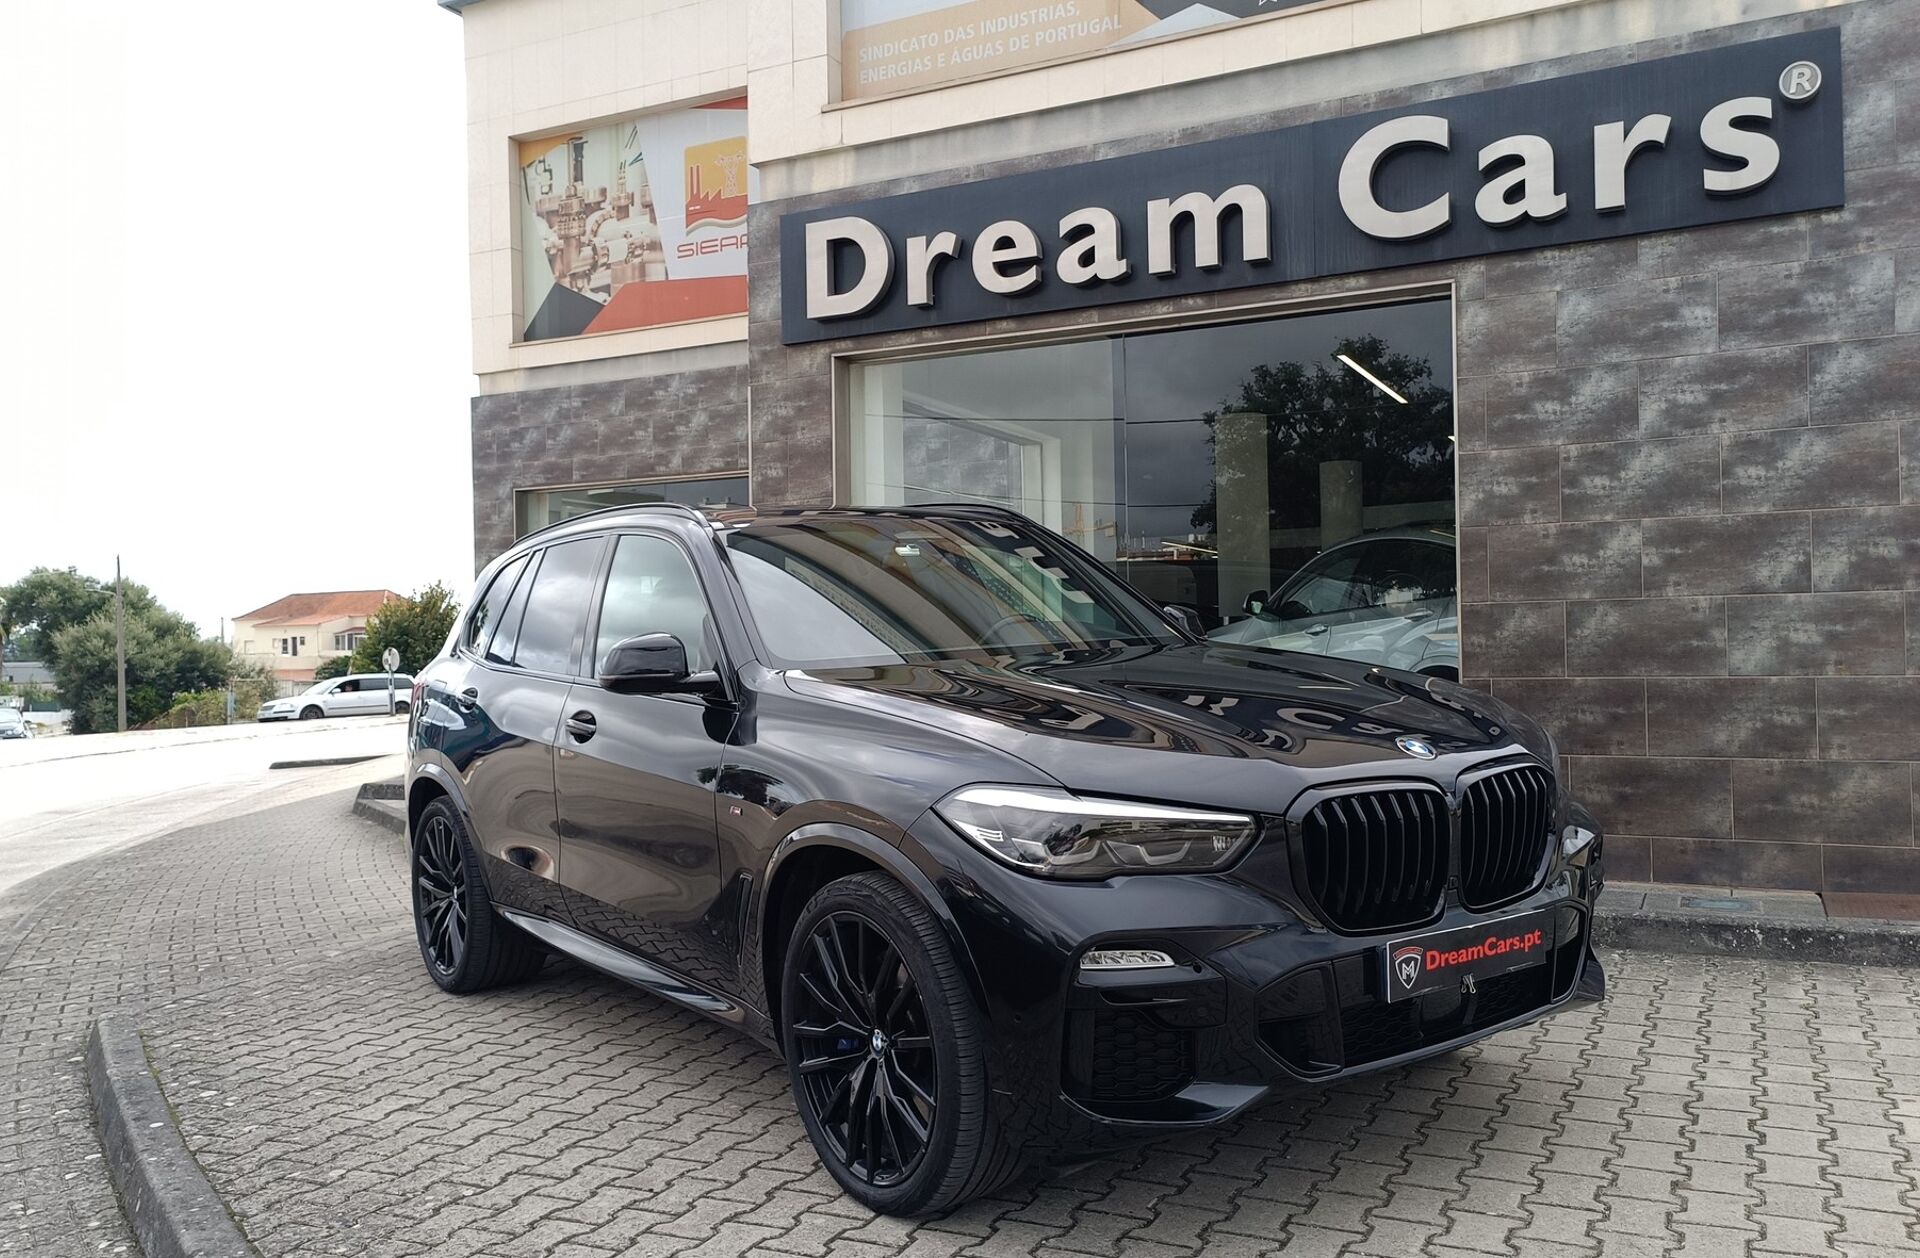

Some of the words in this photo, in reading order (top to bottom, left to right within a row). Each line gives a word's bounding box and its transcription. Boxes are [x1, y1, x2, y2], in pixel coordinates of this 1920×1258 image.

[859, 32, 939, 63] SINDICATO
[944, 23, 975, 44] DAS
[859, 55, 932, 84] ENERGIAS
[937, 53, 946, 68] E
[951, 39, 1004, 65] ÁGUAS
[1008, 34, 1030, 52] DE
[1035, 14, 1122, 47] PORTUGAL
[805, 183, 1272, 321] Dream
[1338, 96, 1781, 241] Cars
[1426, 928, 1542, 972] DreamCars.pt
